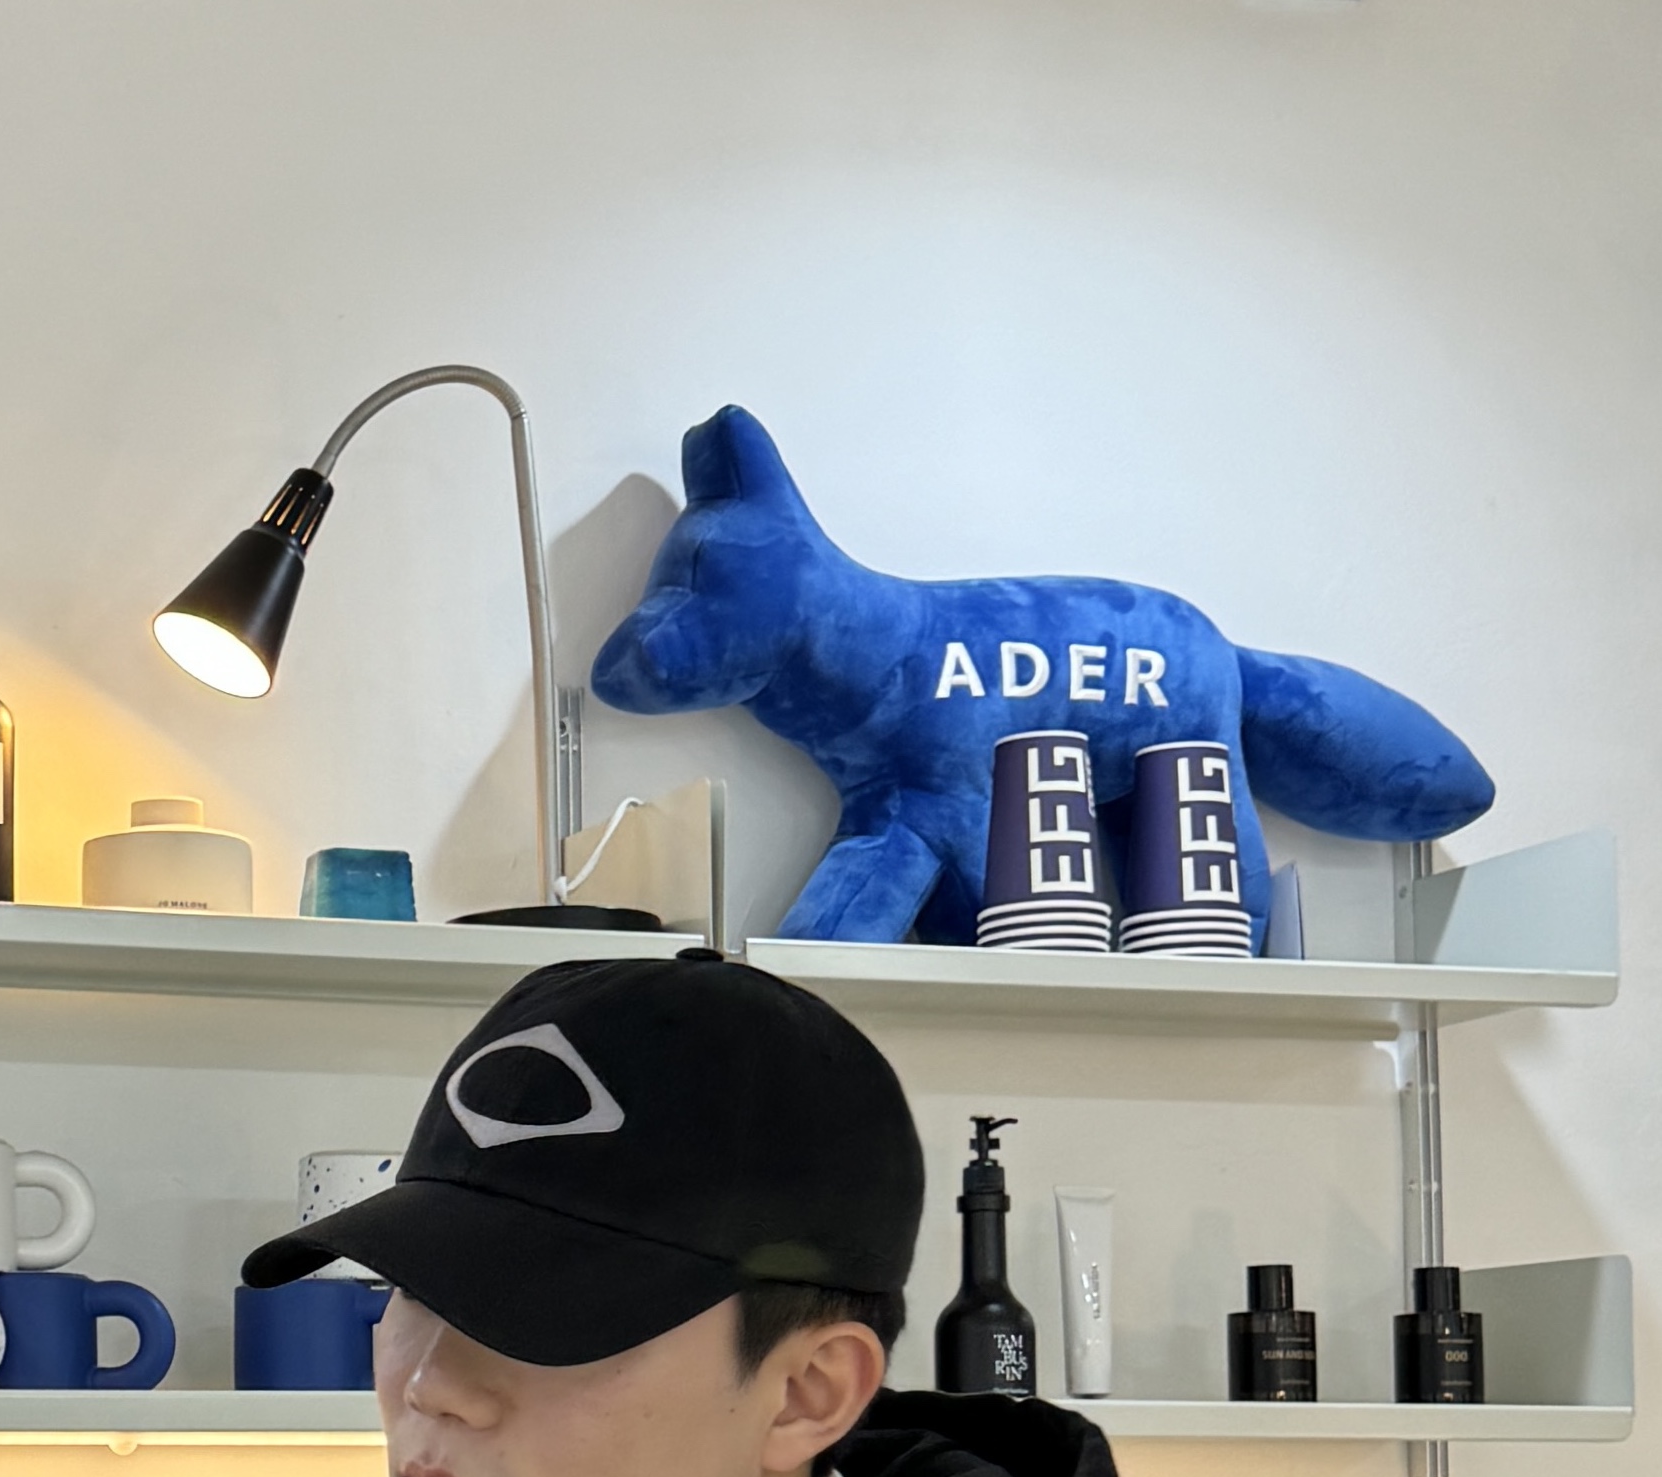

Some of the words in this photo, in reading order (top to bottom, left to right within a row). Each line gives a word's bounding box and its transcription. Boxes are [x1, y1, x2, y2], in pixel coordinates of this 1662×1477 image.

[935, 641, 1169, 707] ADER
[1027, 745, 1095, 894] EFG
[1177, 756, 1241, 903] EFG
